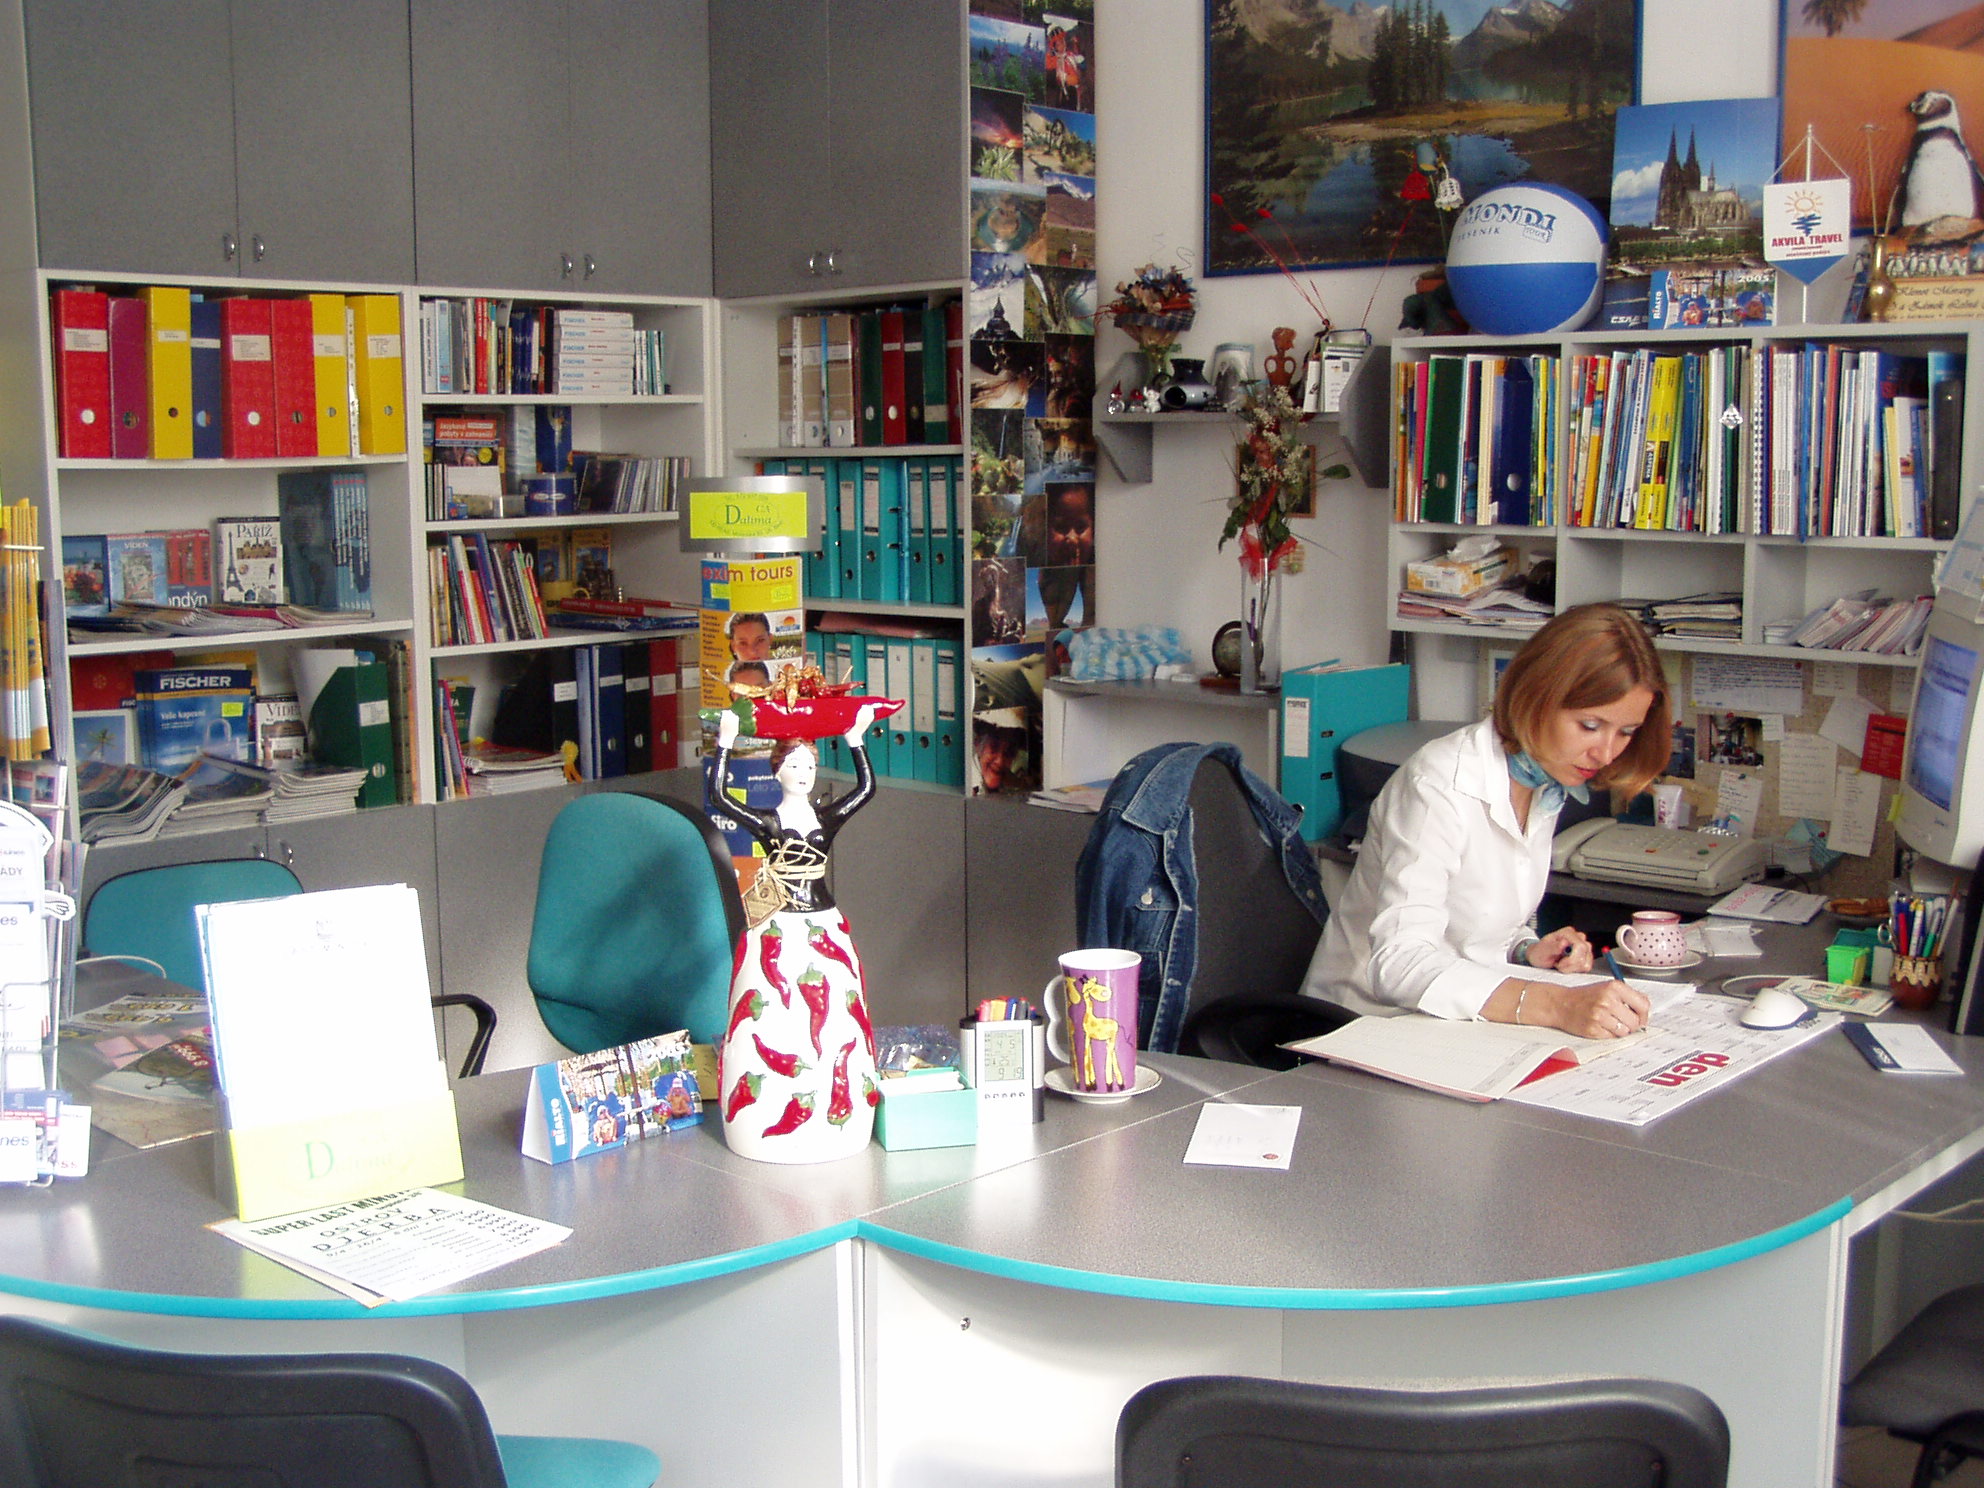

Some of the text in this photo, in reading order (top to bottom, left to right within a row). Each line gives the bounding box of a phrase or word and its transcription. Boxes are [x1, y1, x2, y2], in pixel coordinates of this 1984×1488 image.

[1464, 202, 1556, 230] MONDI
[1772, 234, 1843, 247] AKVILA TRAVEL
[1738, 275, 1770, 283] 2005
[725, 504, 772, 525] Dalima
[702, 565, 793, 582] exim tours
[159, 675, 232, 691] FISCHER
[1646, 1052, 1730, 1087] den
[250, 1219, 316, 1236] SUPER
[310, 1206, 355, 1223] LAST
[319, 1207, 402, 1237] OSTROV
